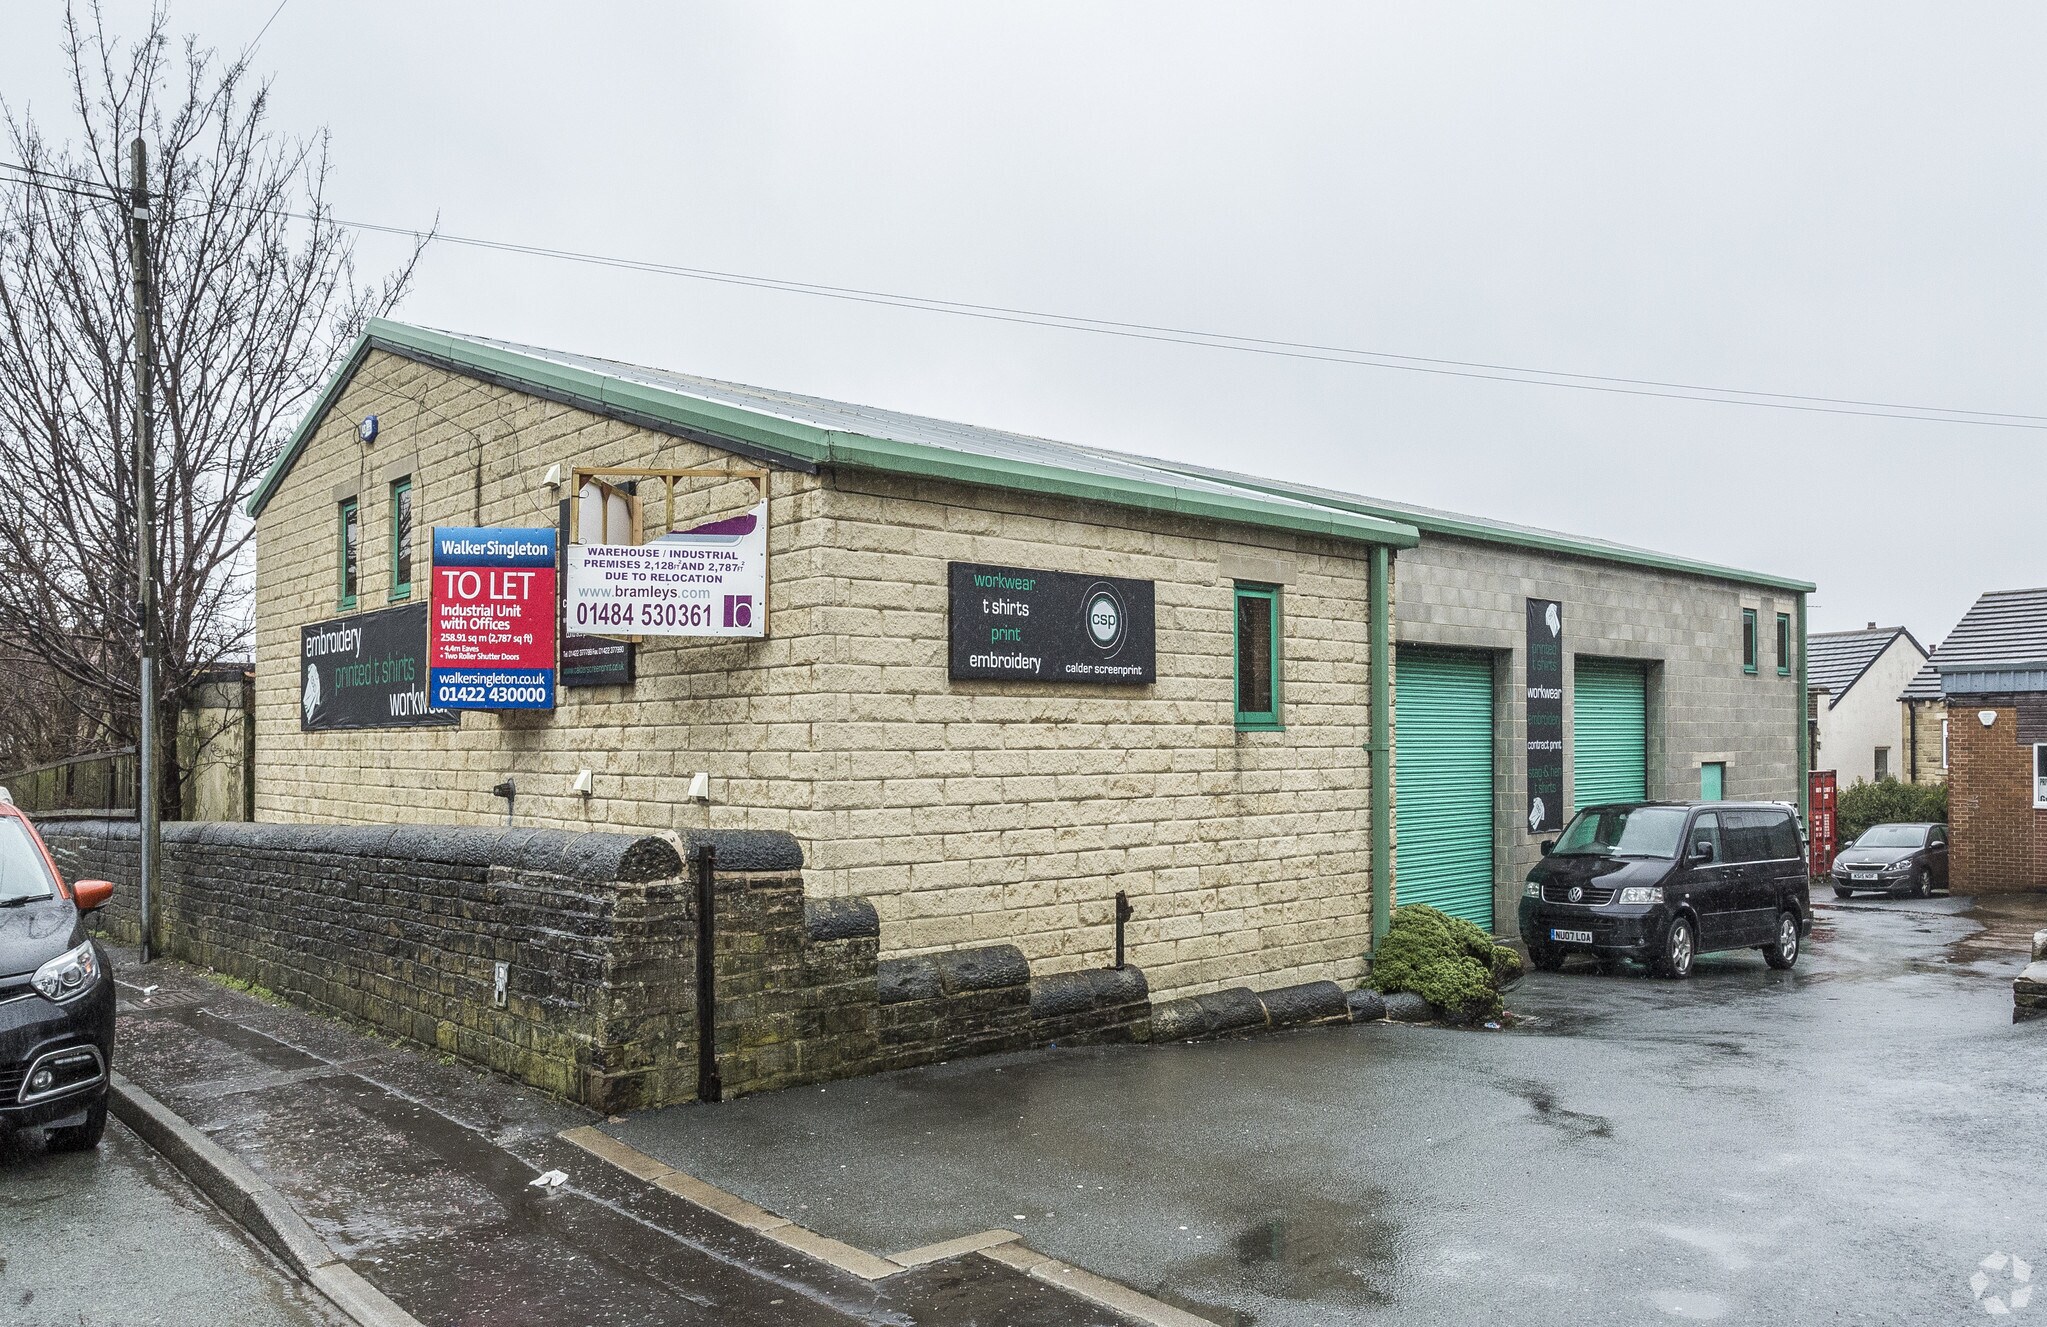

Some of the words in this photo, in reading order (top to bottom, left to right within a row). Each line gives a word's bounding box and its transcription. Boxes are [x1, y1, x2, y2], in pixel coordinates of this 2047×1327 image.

[587, 548, 660, 558] WAREHOUSE
[669, 550, 739, 560] INDUSTRIAL
[584, 559, 642, 569] PREMISES
[441, 571, 481, 599] TO
[489, 571, 536, 600] LET
[605, 572, 629, 581] DUE
[632, 573, 647, 582] TO
[650, 574, 723, 584] RELOCATION
[974, 573, 1036, 591] workwear
[578, 585, 711, 601] www.bramleys.com
[441, 603, 494, 617] Industrial
[497, 604, 521, 617] Unit
[577, 602, 634, 626] 01484
[641, 604, 712, 628] 530361
[983, 600, 990, 614] t
[992, 599, 1030, 617] shirts
[440, 617, 467, 630] with
[469, 617, 511, 631] Offices
[1092, 613, 1116, 629] csp
[306, 622, 362, 659] embroidery
[440, 633, 467, 642] 258.91
[468, 635, 477, 645] sq
[488, 632, 512, 644] (2,787
[513, 636, 522, 646] sq
[523, 633, 533, 645] ft)
[991, 625, 1021, 644] print
[444, 645, 461, 653] 4.4m
[477, 653, 501, 661] Shutter
[501, 653, 520, 661] Doors
[969, 652, 1041, 673] embroidery
[335, 655, 373, 697] printed
[374, 660, 380, 685] t
[382, 650, 415, 684] shirts
[1066, 663, 1093, 673] calder
[1094, 664, 1142, 676] screenprint
[439, 672, 545, 687] walkersingleton.co.uk
[440, 687, 485, 702] 01422
[489, 688, 545, 702] 430000
[1527, 684, 1562, 699] workwear
[1527, 740, 1549, 750] contract
[1549, 741, 1562, 752] print
[1556, 931, 1575, 940] NU07
[1576, 933, 1590, 942] LOA
